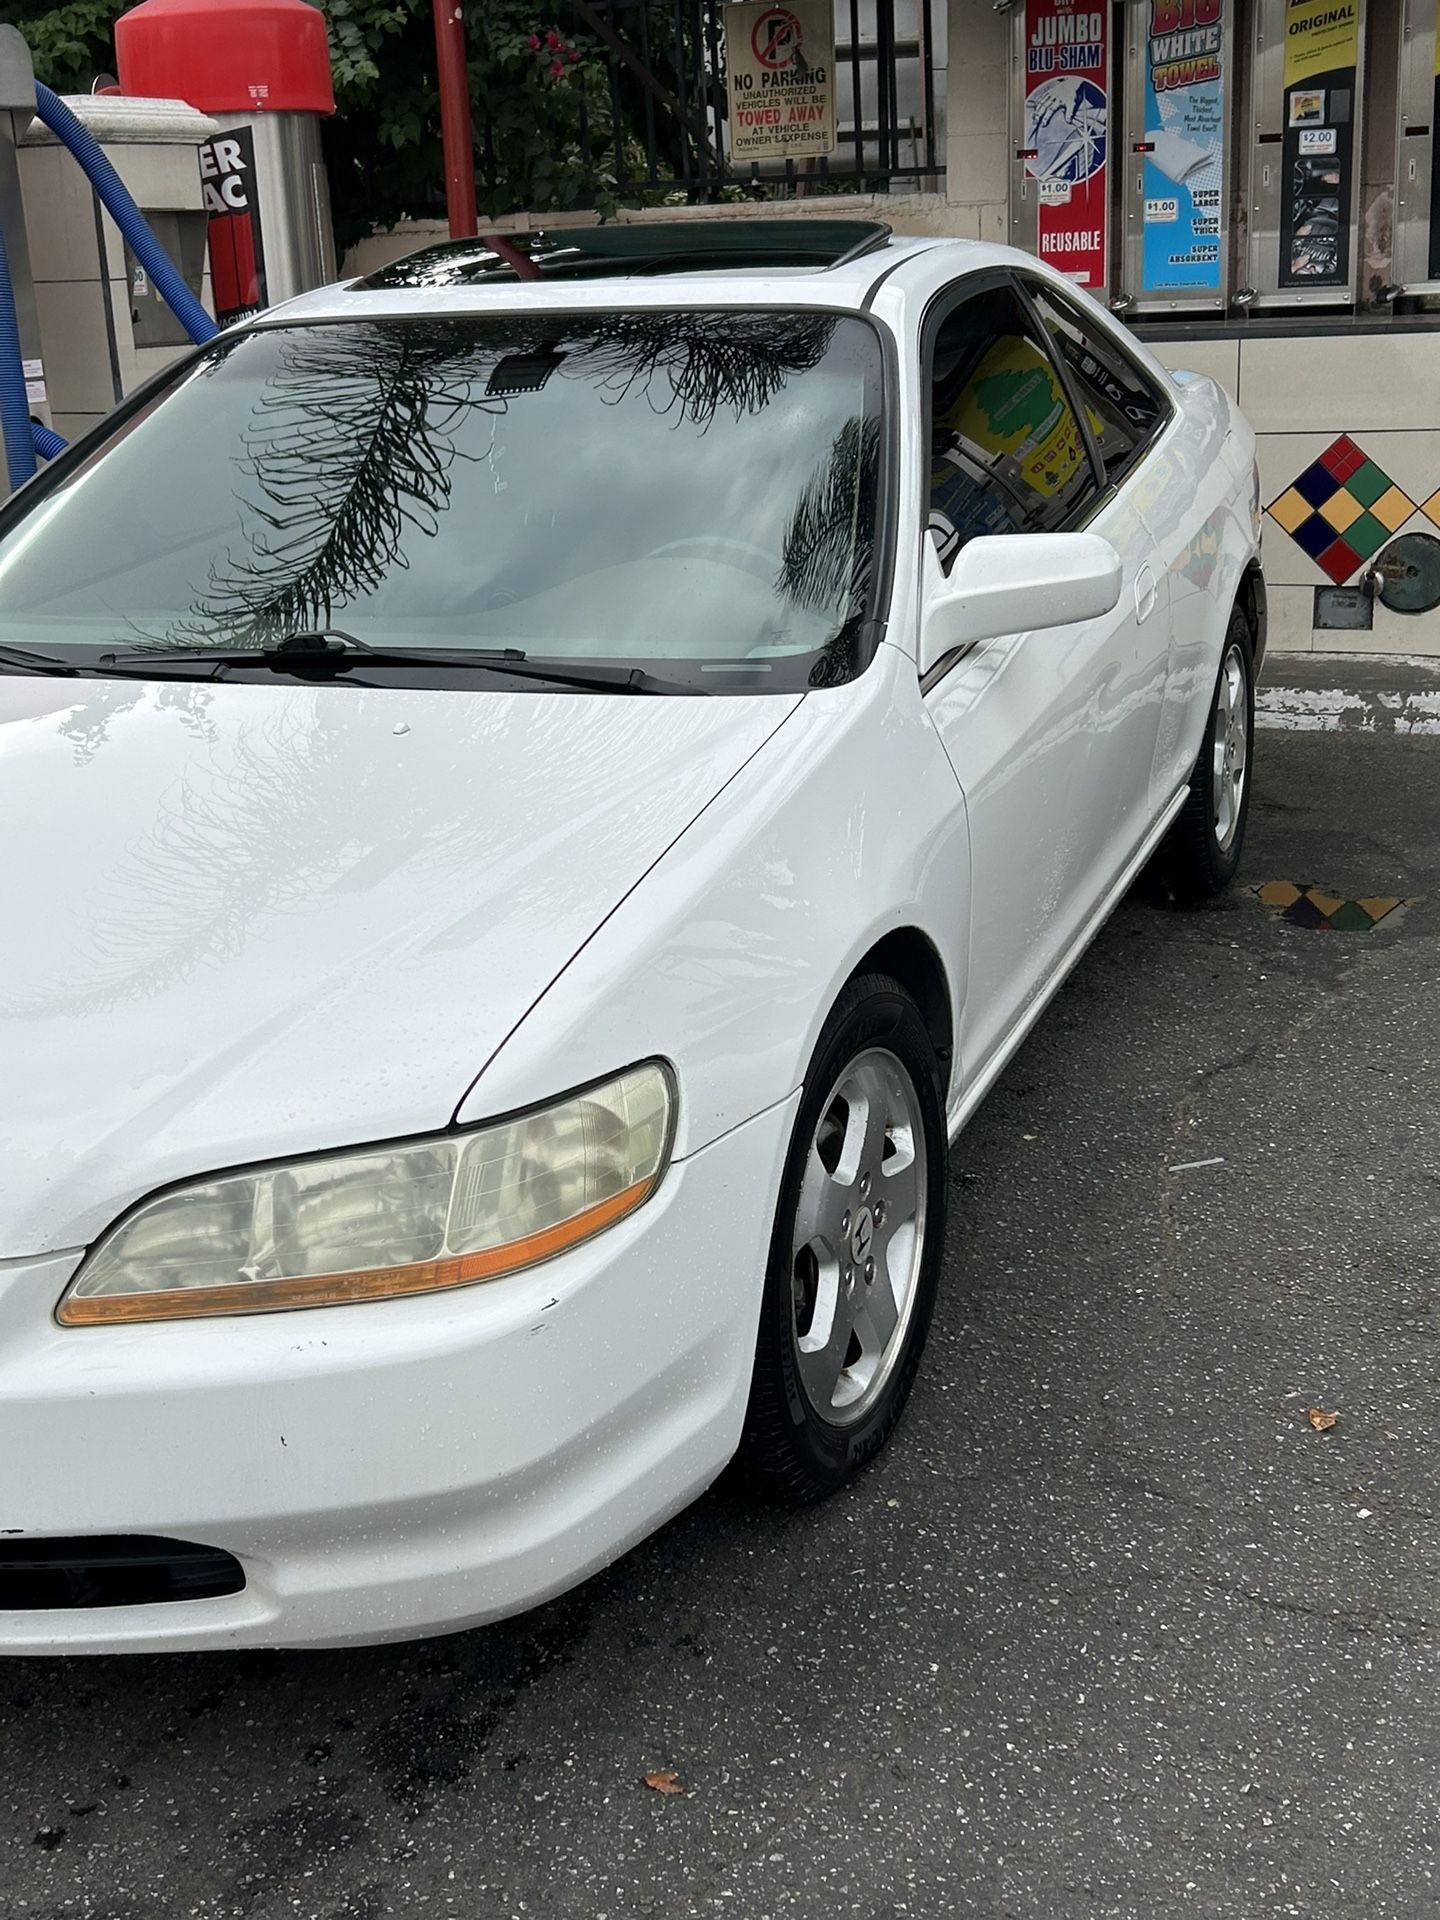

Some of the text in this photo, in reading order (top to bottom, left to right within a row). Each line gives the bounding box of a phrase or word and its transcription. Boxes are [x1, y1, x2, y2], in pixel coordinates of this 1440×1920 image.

[1289, 5, 1355, 35] ORIGINAL
[1031, 13, 1102, 46] JUMBO
[1152, 26, 1219, 62] WHITE
[1028, 44, 1101, 72] BLU-SHAM
[734, 67, 826, 91] NO PARKING
[1154, 58, 1219, 89] TOWEL
[743, 86, 816, 100] UNAUTHORIZED
[735, 95, 827, 110] VEHICLES WILL BE
[737, 105, 825, 127] TOWED AWAY
[752, 123, 809, 136] AT VEHICLE
[780, 131, 828, 143] EXPENSE
[1304, 132, 1332, 143] $2.00
[1041, 183, 1069, 193] $1.00
[1192, 190, 1219, 199] SUPER
[1147, 201, 1175, 212] $1.00
[1193, 199, 1219, 207] LARGE
[1192, 217, 1219, 226] SUPER
[1193, 226, 1219, 235] THICK
[1041, 231, 1101, 253] REUSABLE
[1191, 245, 1218, 254] SUPER
[1169, 254, 1218, 264] ABSORBENT
